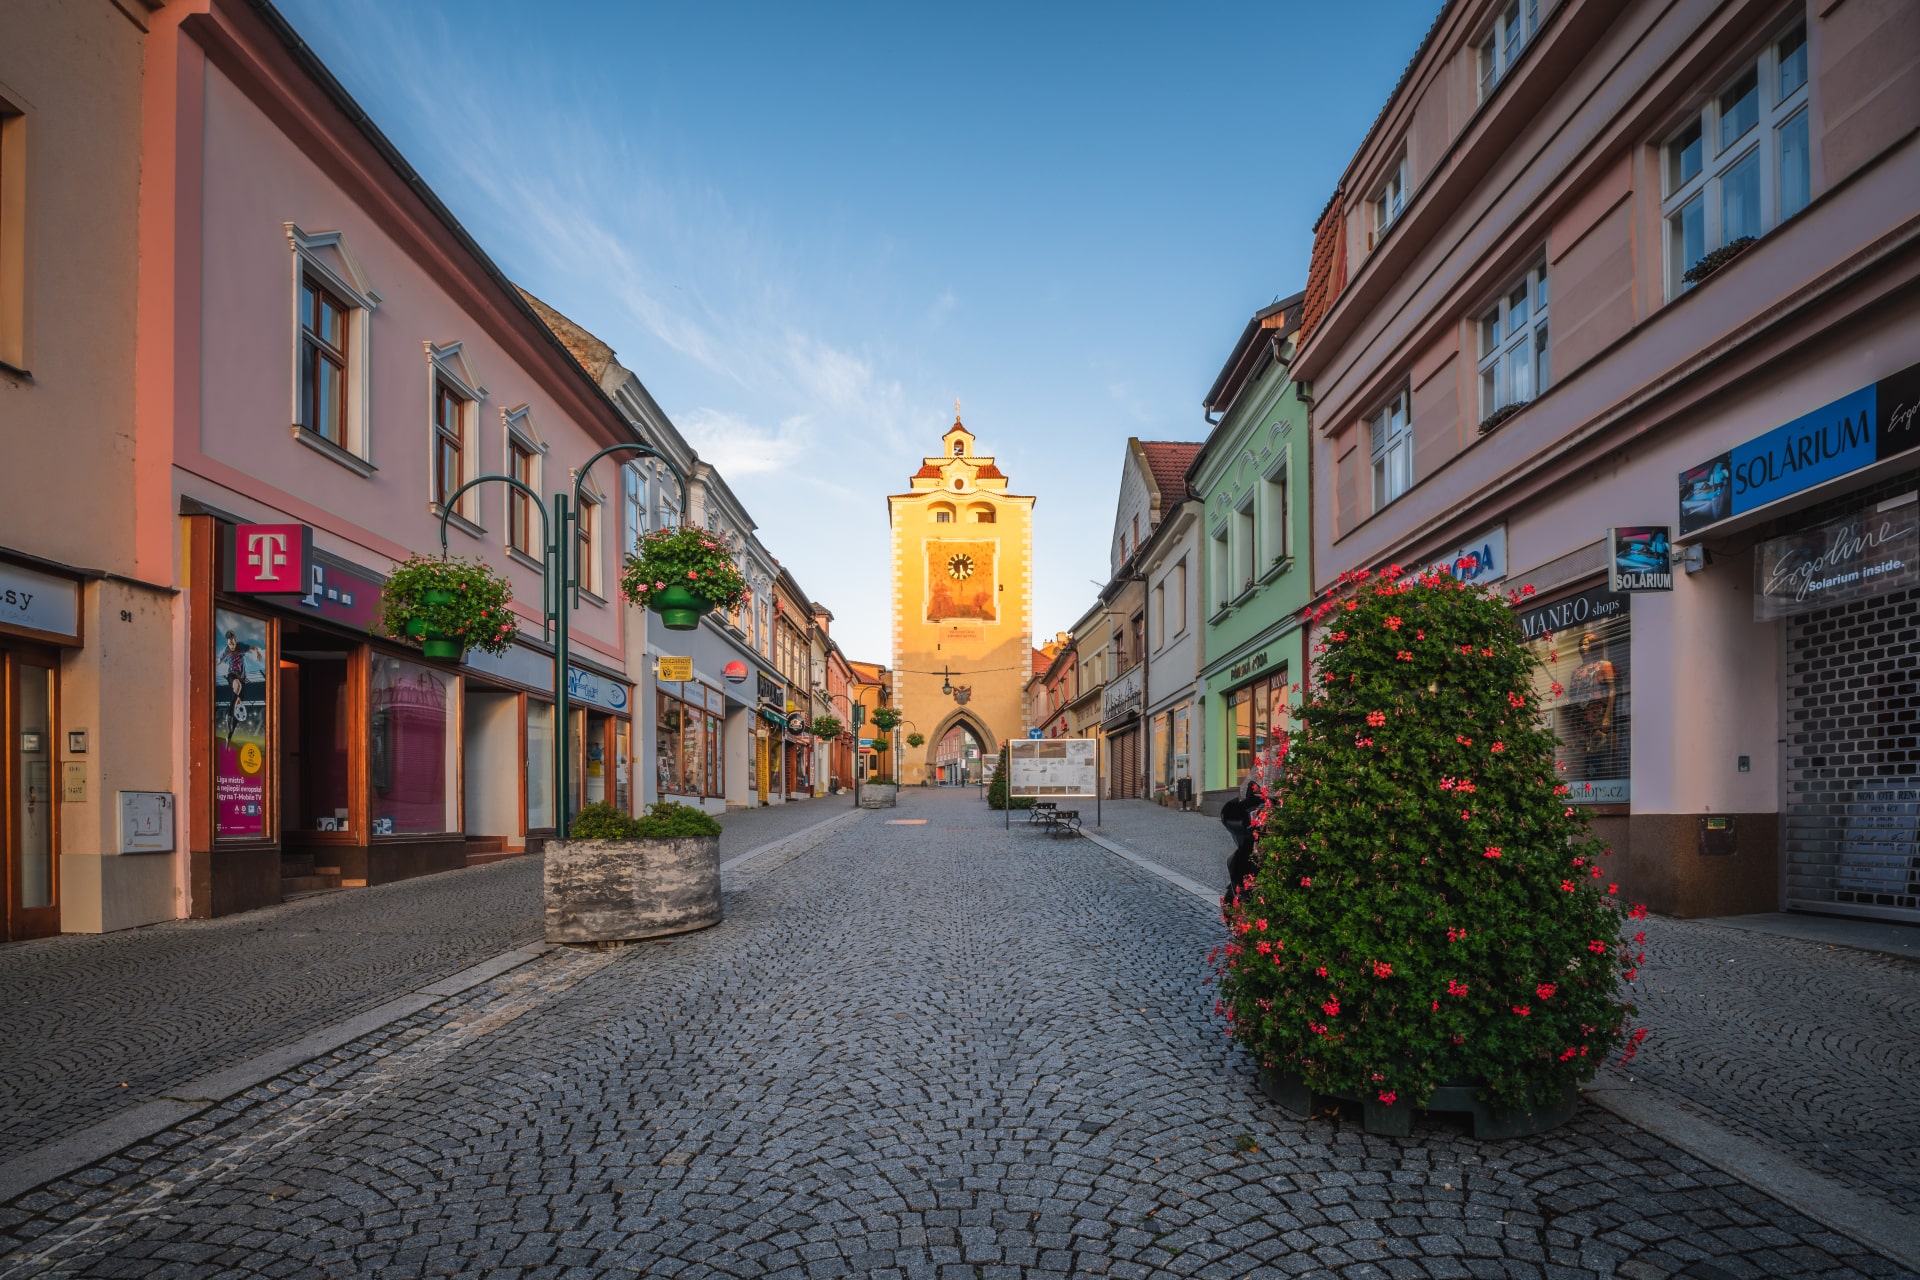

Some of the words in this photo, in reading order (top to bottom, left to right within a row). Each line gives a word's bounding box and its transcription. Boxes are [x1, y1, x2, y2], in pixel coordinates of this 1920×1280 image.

[1735, 410, 1870, 495] SOLÁRIUM
[248, 534, 286, 580] T
[1809, 572, 1859, 592] Solarium
[1863, 560, 1905, 578] inside.
[0, 589, 33, 611] sy
[120, 610, 132, 622] 91
[1521, 597, 1589, 637] MANEO
[1592, 599, 1620, 617] shops
[217, 776, 227, 784] Liga
[234, 793, 255, 801] T-Mobile
